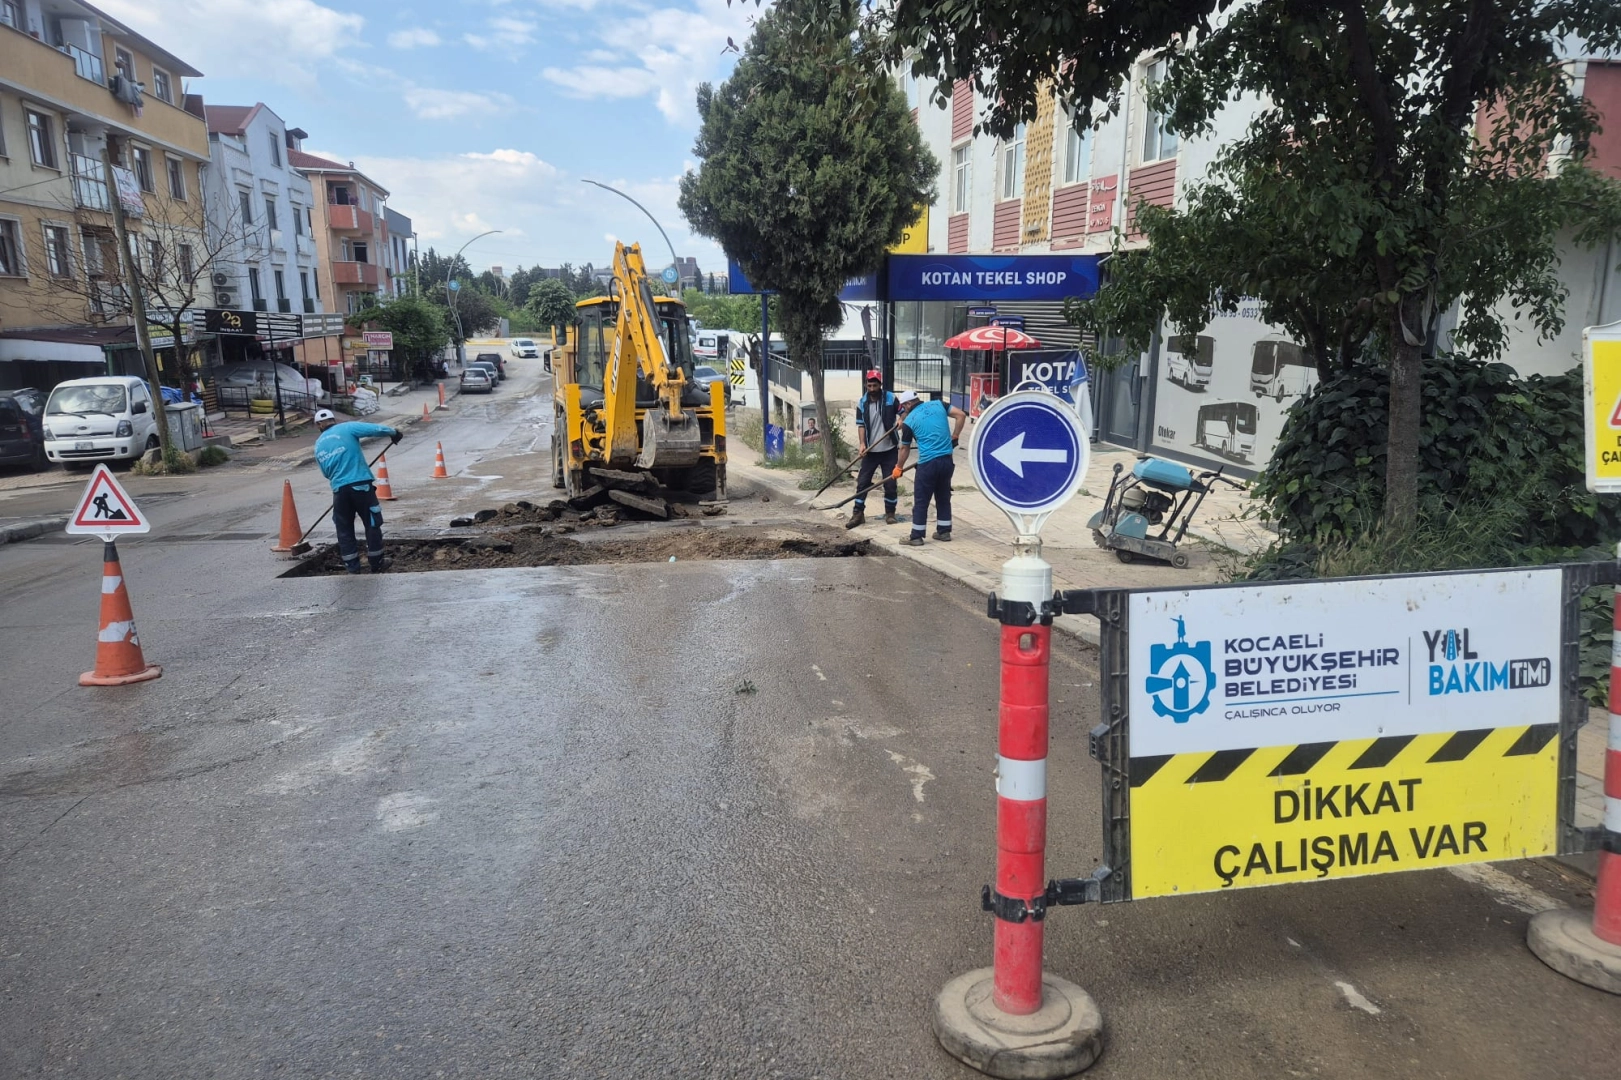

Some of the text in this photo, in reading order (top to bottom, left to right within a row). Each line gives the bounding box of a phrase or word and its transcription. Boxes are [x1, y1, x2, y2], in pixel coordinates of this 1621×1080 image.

[921, 271, 1067, 285] KOTAN TEKEL SHOP
[1022, 361, 1077, 382] KOTA
[1602, 450, 1621, 466] ÇA
[1429, 660, 1509, 696] BAKIM
[1224, 703, 1341, 720] ÇALIŞINCA OLUYOR
[1274, 778, 1422, 824] DİKKAT
[1213, 821, 1488, 888] ÇALIŞMA VAR
